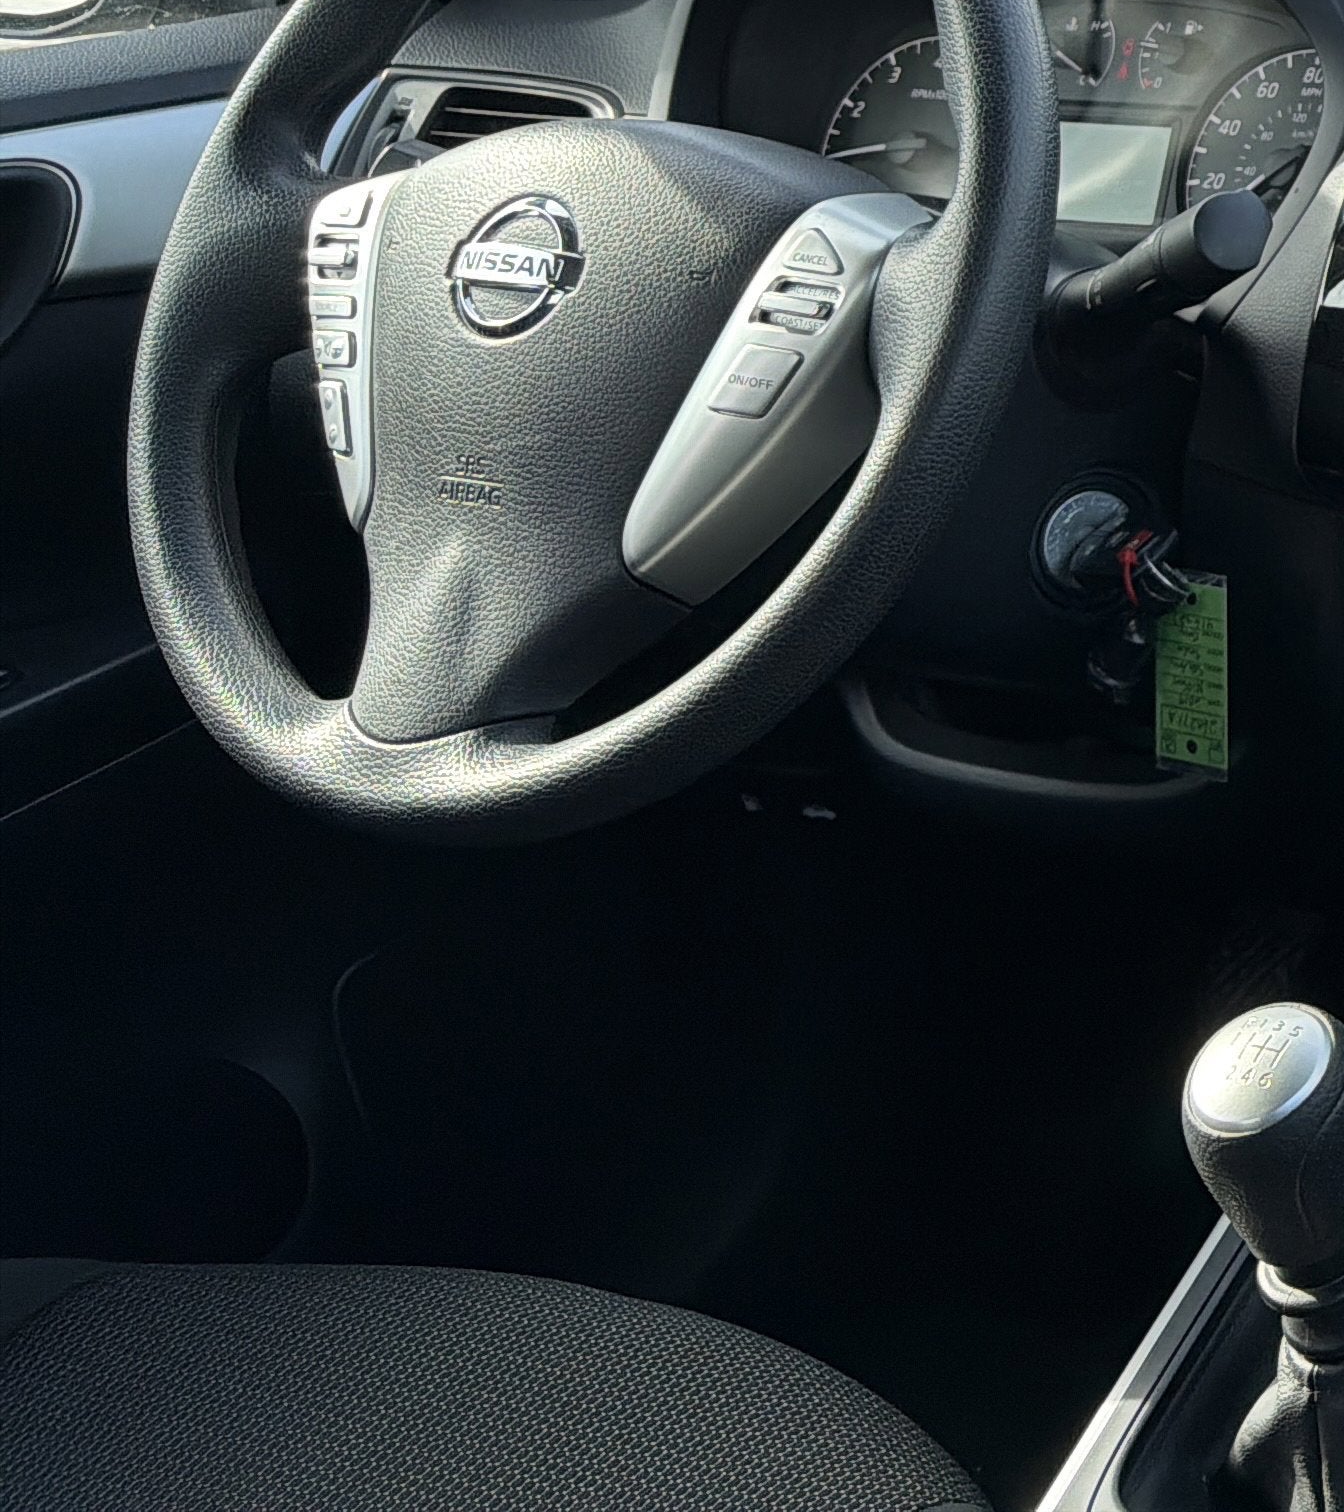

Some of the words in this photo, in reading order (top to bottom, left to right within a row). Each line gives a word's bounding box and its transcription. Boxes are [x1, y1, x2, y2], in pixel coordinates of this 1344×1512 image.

[887, 66, 902, 84] 3
[1302, 66, 1325, 84] 80
[1256, 81, 1280, 99] 60
[1300, 86, 1323, 98] MPH
[850, 100, 866, 118] 2
[1218, 119, 1242, 136] 40
[1201, 172, 1226, 190] 20
[460, 249, 565, 283] NISSAN
[792, 252, 829, 267] CANCEL
[775, 315, 824, 331] COAST/SET
[727, 373, 776, 391] ON/OFF
[438, 479, 503, 506] AIRBAG
[1272, 1020, 1287, 1032] 3
[1288, 1025, 1304, 1038] 5
[1240, 1067, 1257, 1084] 4
[1257, 1071, 1274, 1091] 6
